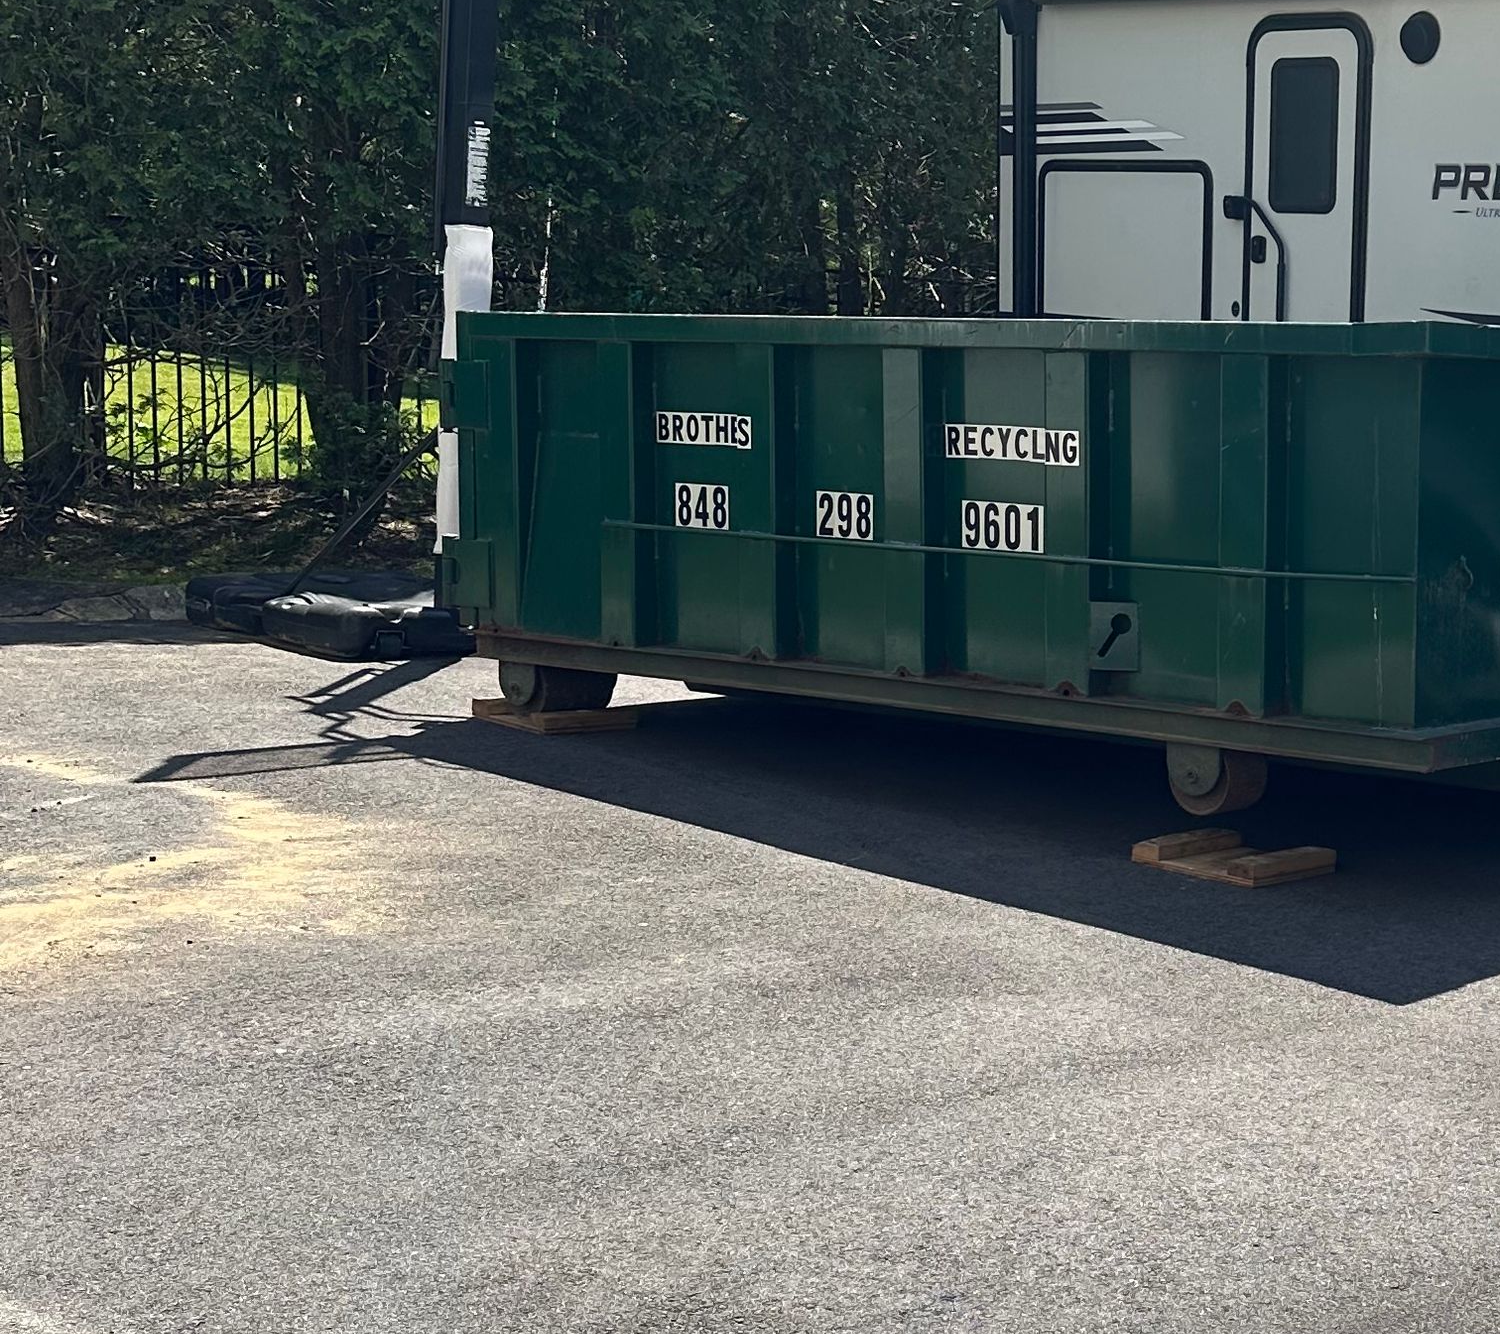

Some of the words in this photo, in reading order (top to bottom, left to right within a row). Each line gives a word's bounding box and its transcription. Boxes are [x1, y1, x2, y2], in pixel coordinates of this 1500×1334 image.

[657, 413, 750, 447] BROTHES
[947, 426, 1078, 464] RECYCLNG
[678, 484, 727, 529] 848
[819, 493, 871, 539] 298
[965, 502, 1039, 552] 9601
